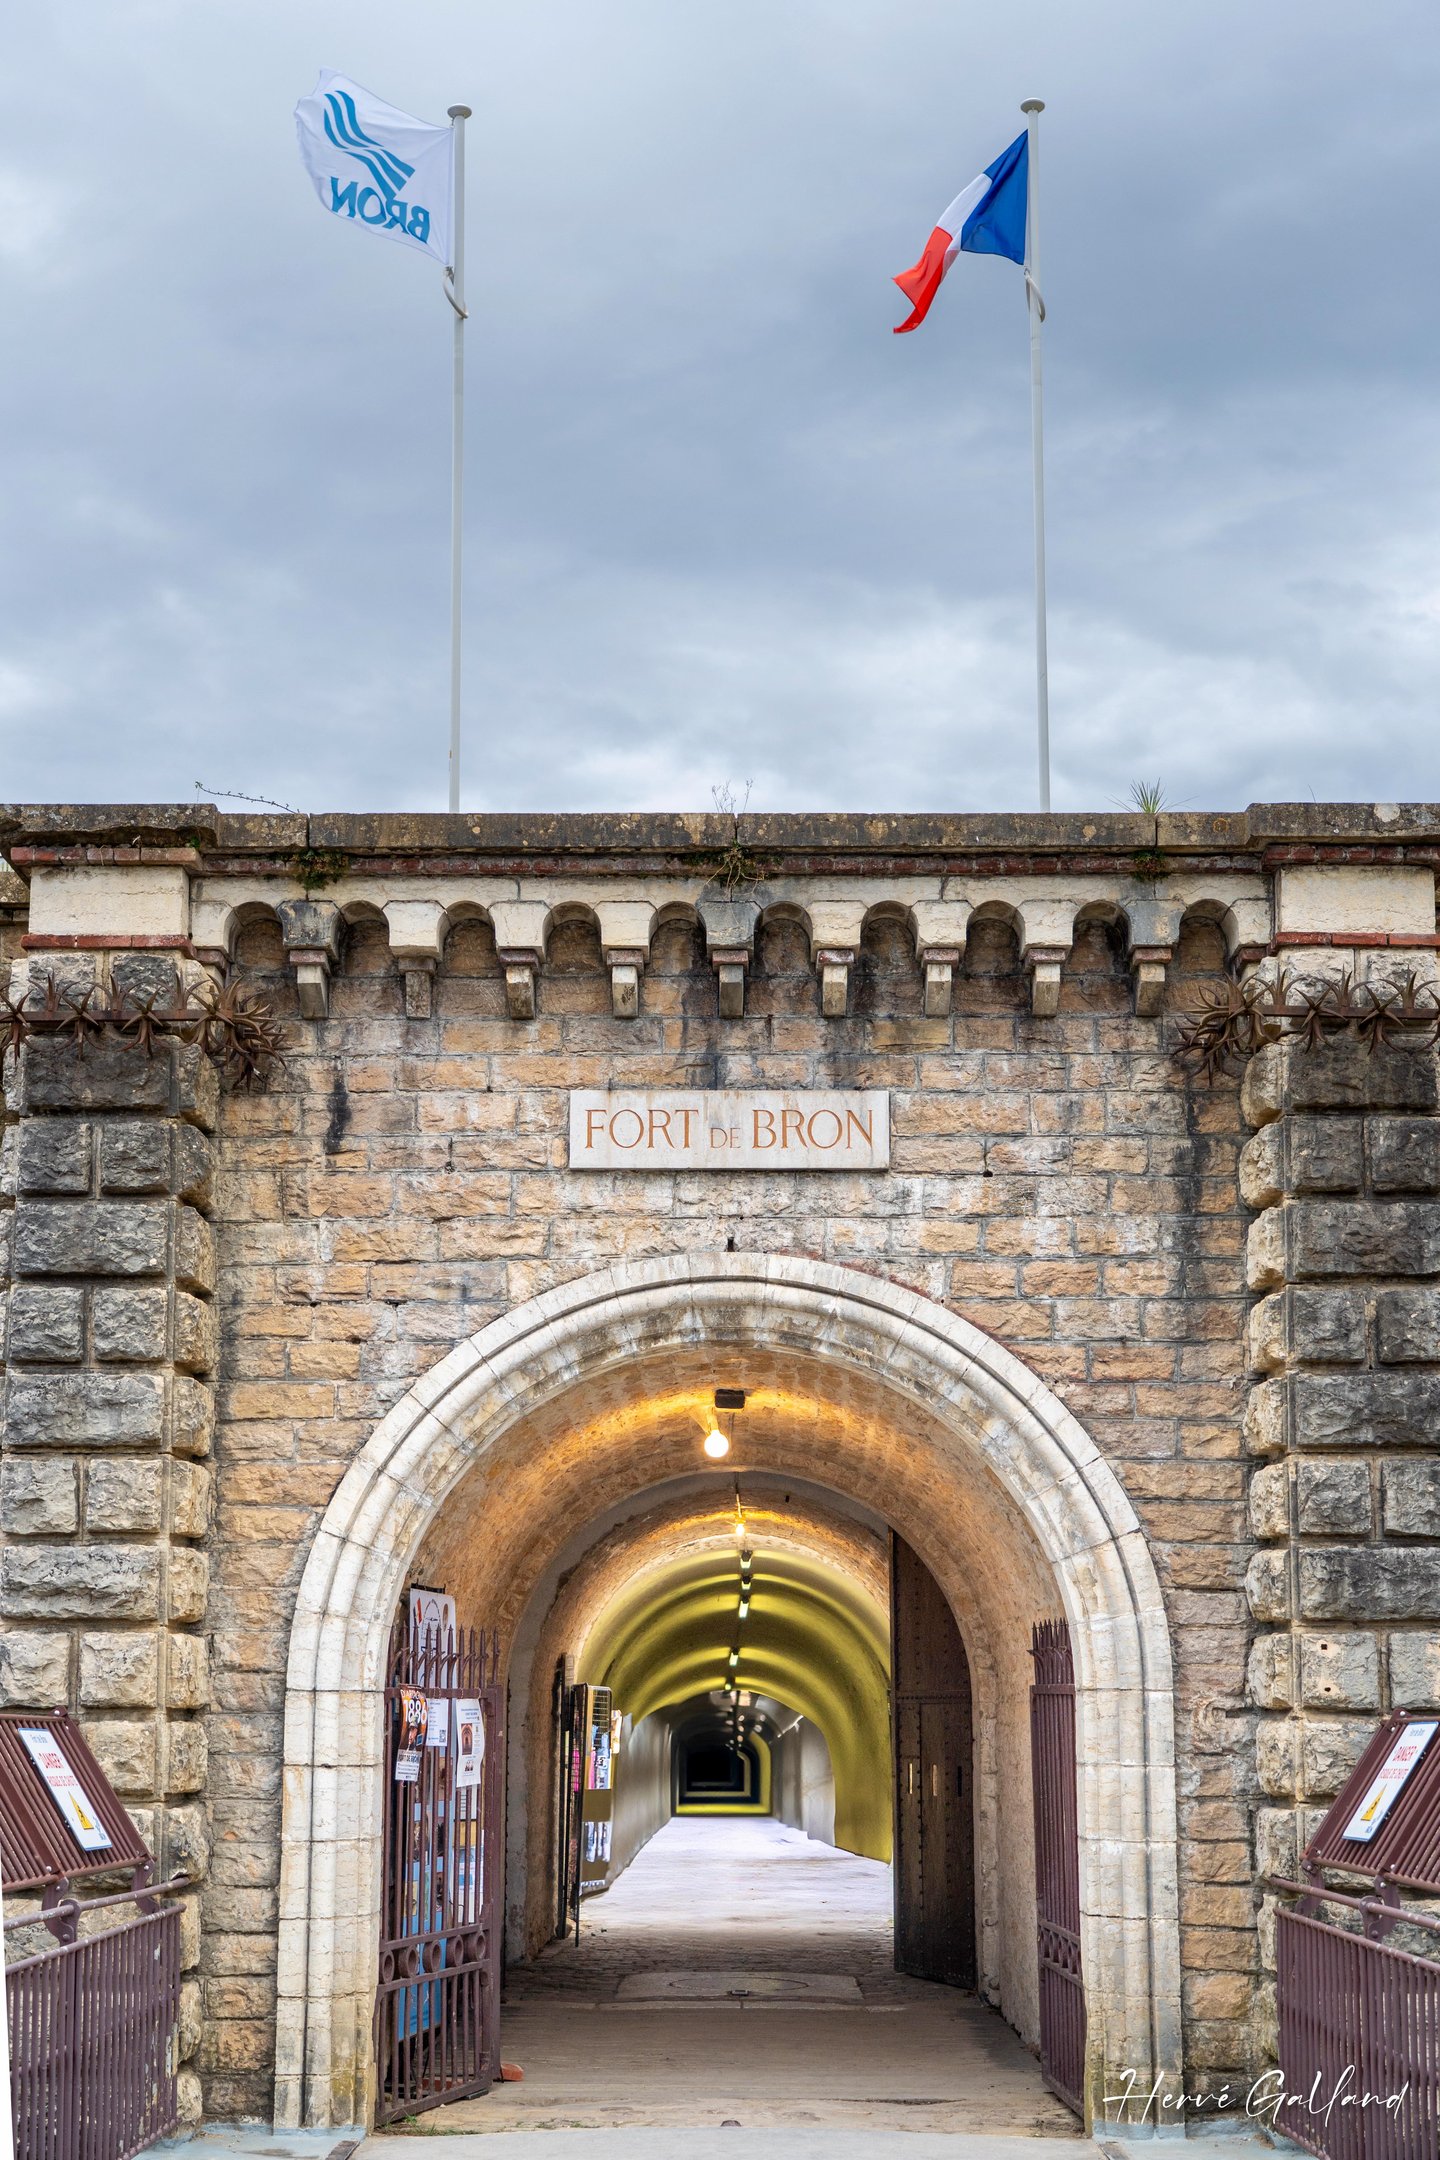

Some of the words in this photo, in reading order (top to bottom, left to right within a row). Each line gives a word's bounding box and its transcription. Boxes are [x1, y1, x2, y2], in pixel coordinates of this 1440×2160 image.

[585, 1109, 699, 1149] FORT
[709, 1127, 741, 1149] DE
[752, 1109, 873, 1149] BRON
